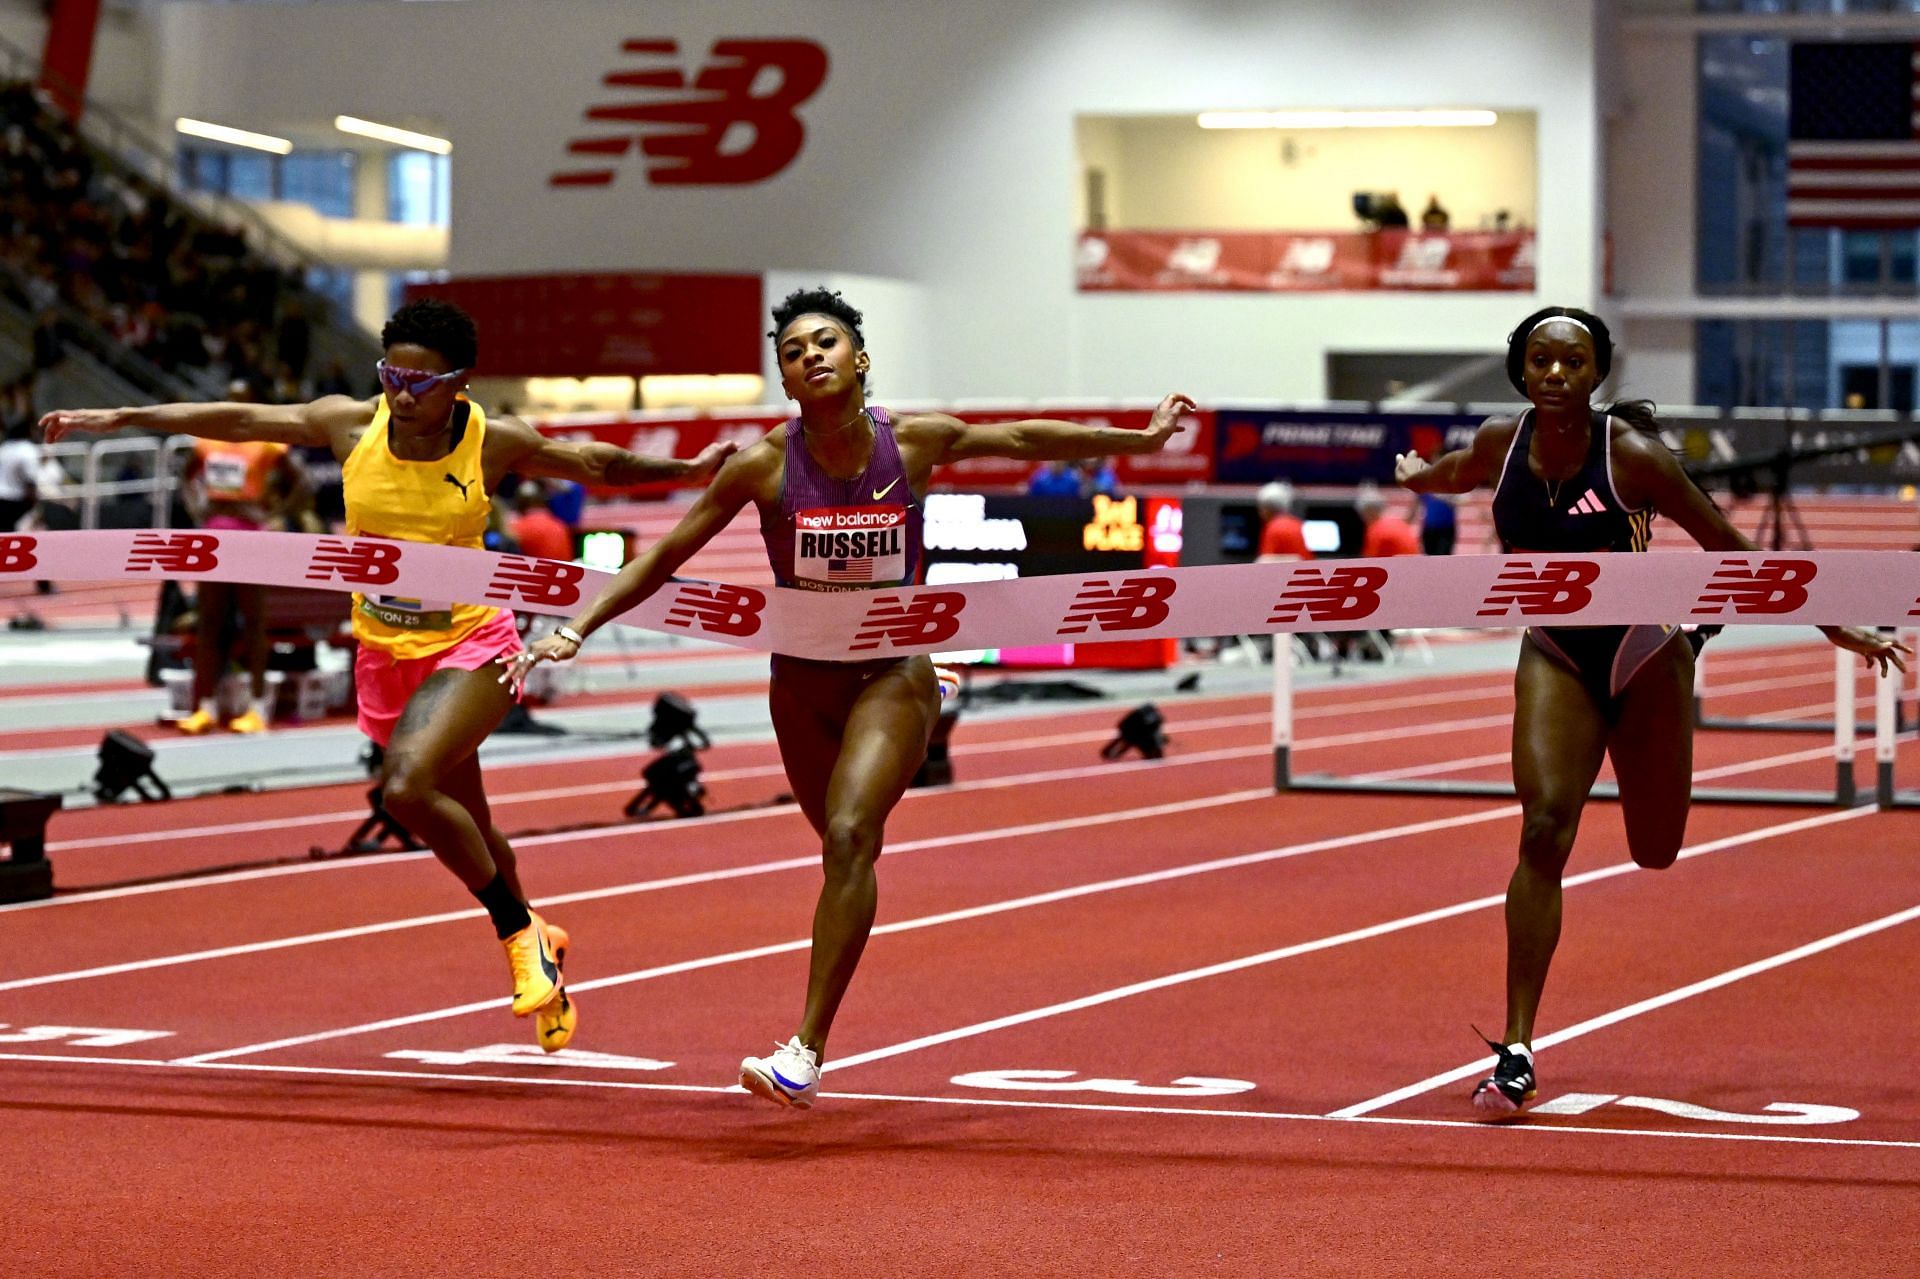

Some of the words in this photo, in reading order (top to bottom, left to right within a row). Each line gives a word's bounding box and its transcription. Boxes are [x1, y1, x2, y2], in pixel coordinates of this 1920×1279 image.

[549, 38, 828, 187] NB
[800, 528, 901, 559] RUSSELL
[803, 515, 834, 527] new
[836, 511, 898, 526] balance
[0, 537, 37, 572] B
[126, 535, 219, 571] NB
[306, 534, 402, 585] NB
[485, 548, 584, 608] NB
[664, 584, 766, 636] NB
[1057, 577, 1176, 631] NB
[1268, 567, 1388, 623] NB
[1480, 561, 1600, 616] NB
[1690, 560, 1817, 614] NB
[849, 592, 966, 650] NB
[1529, 1093, 1860, 1126] 2
